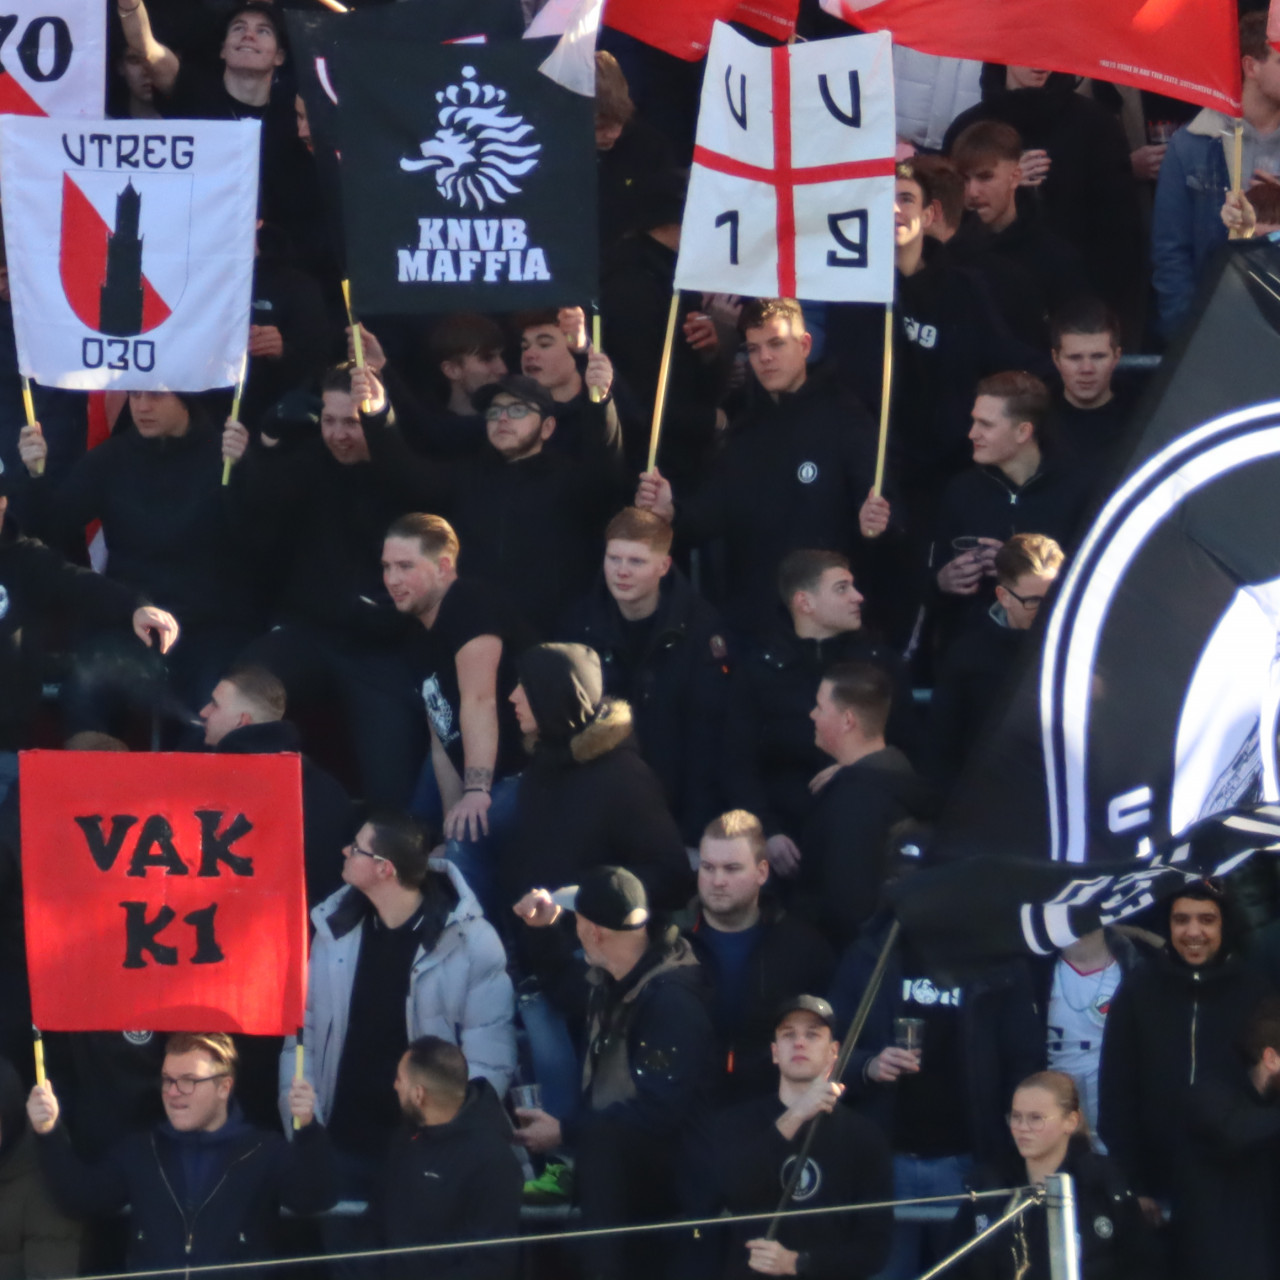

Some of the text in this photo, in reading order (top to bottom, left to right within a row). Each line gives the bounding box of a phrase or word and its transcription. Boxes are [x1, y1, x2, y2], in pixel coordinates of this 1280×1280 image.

[417, 218, 528, 251] KNVB
[397, 248, 551, 282] MAFFIA
[81, 336, 156, 373] 030
[73, 809, 256, 878] VAK
[119, 901, 225, 971] K1
